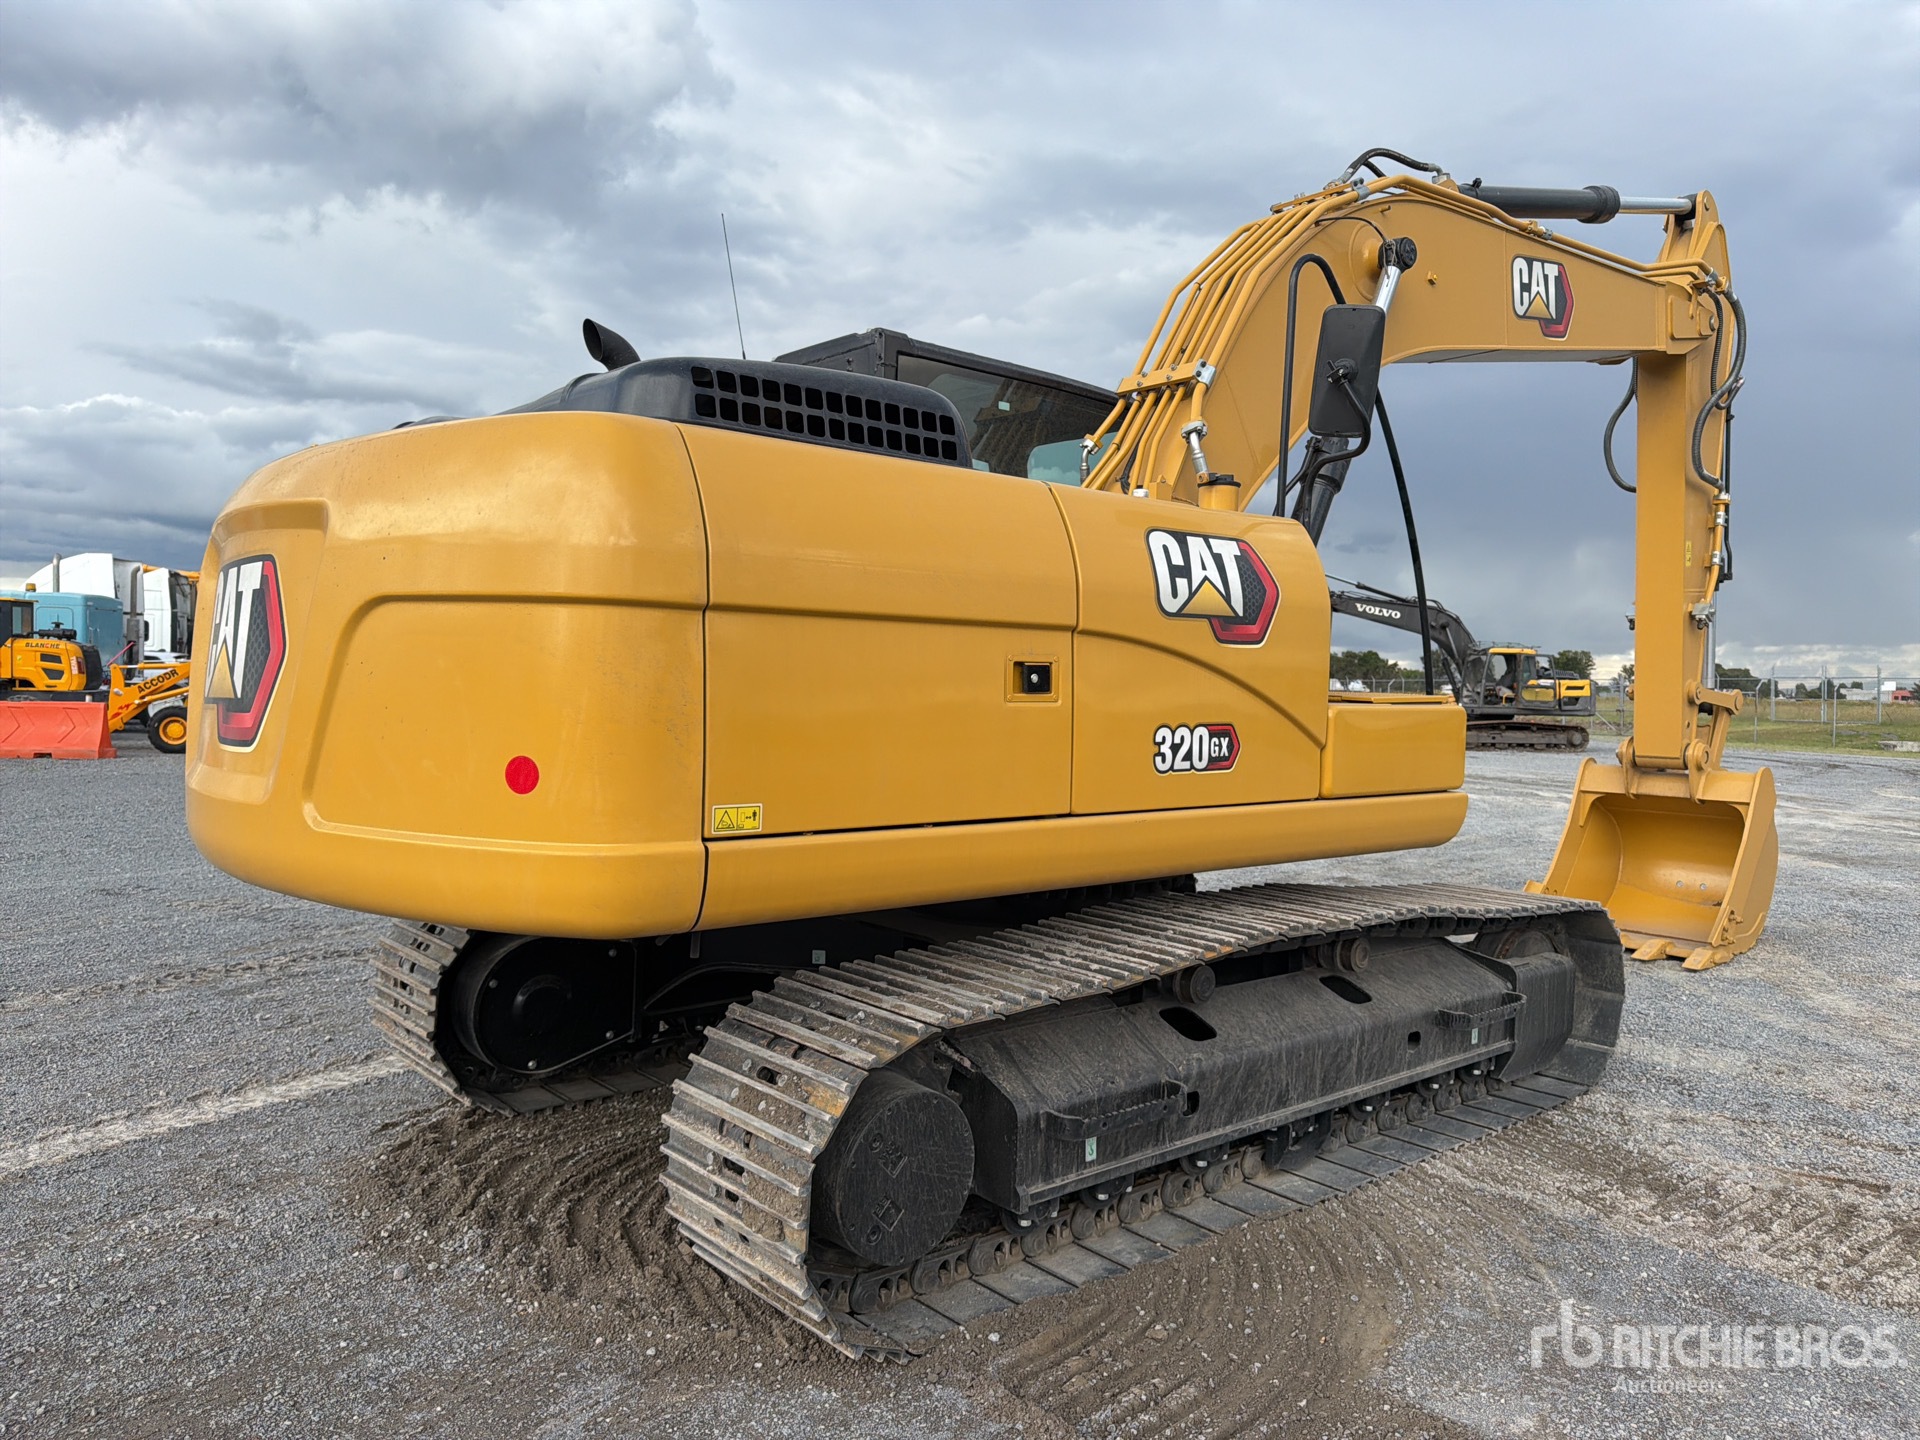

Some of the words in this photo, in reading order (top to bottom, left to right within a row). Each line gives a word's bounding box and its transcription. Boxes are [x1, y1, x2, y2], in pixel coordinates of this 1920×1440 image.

[1512, 256, 1559, 320] CAT
[1148, 530, 1244, 617] CAT
[1354, 602, 1401, 620] VOLVO
[204, 560, 264, 699] CAT
